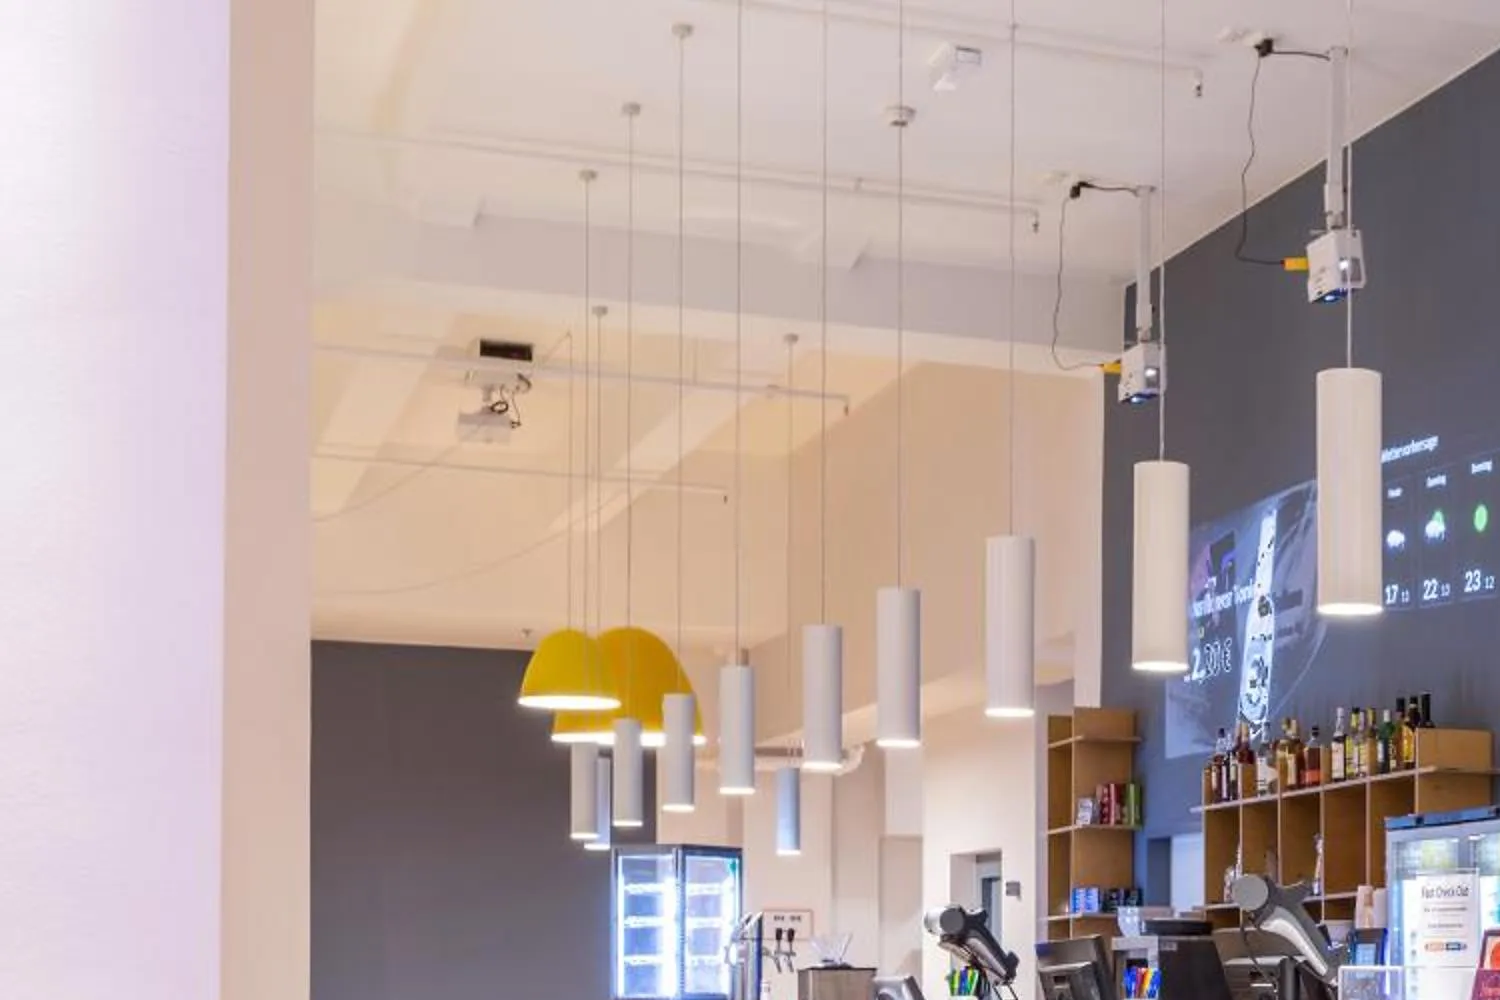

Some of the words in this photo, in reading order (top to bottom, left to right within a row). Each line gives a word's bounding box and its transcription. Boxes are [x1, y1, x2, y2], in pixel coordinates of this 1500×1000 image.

[1423, 578, 1438, 601] 22
[1464, 569, 1481, 593] 23
[1385, 583, 1399, 605] 17
